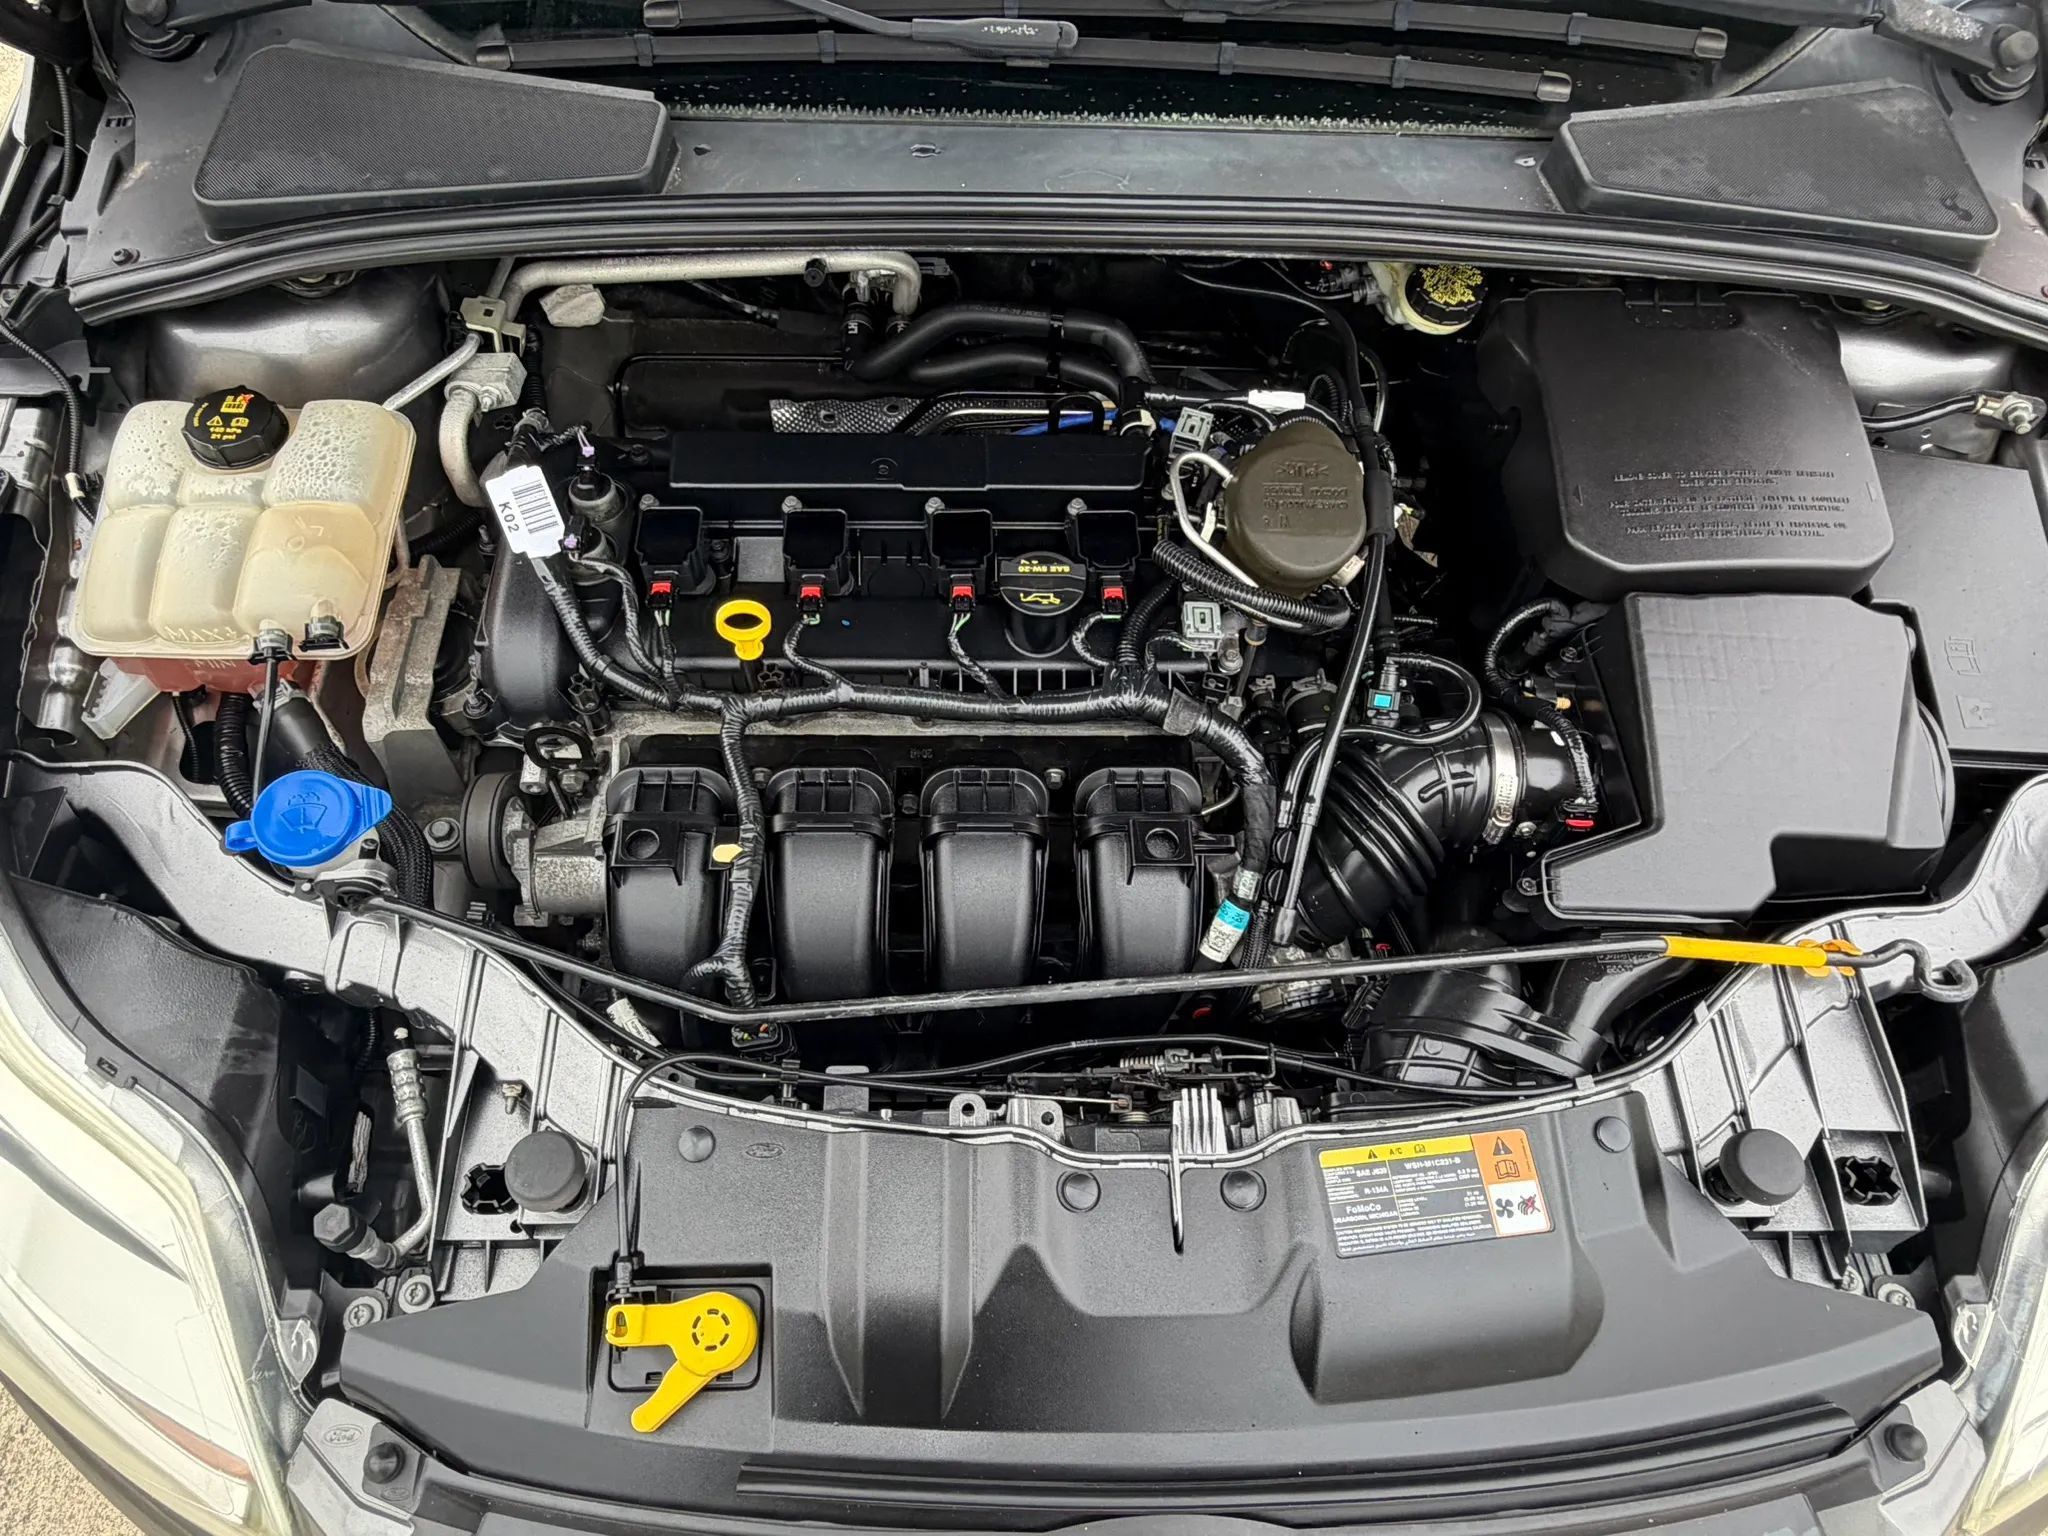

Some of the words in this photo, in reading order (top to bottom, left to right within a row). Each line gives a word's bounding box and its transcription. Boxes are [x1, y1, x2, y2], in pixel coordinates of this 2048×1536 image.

[498, 501, 520, 534] K02
[1050, 565, 1070, 573] SAE
[1389, 1147, 1403, 1156] A/C
[1364, 1185, 1389, 1195] R-134A
[1346, 1203, 1382, 1215] FoMoCo
